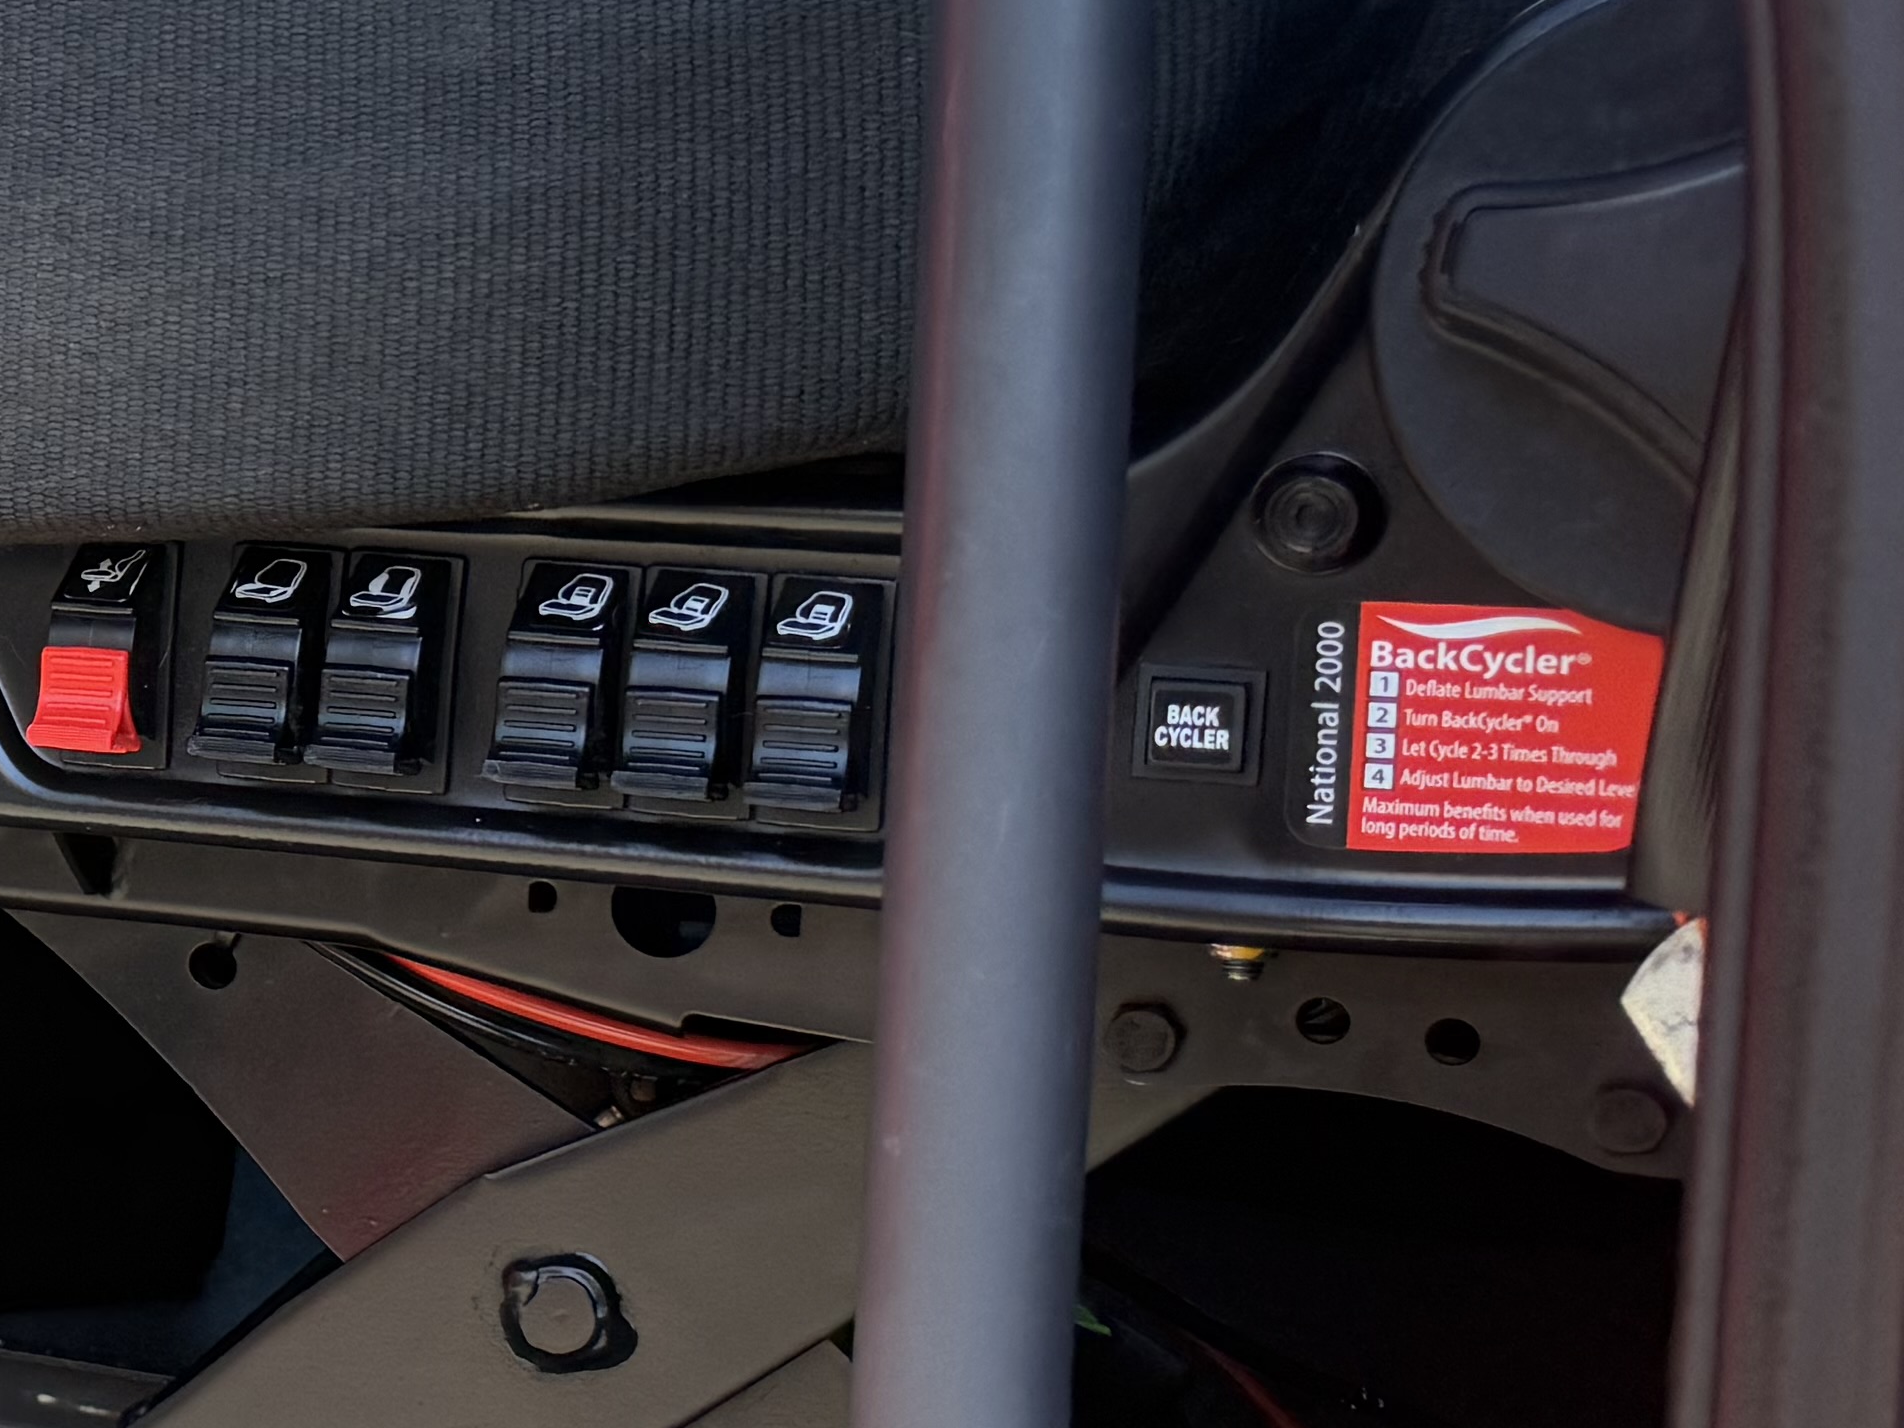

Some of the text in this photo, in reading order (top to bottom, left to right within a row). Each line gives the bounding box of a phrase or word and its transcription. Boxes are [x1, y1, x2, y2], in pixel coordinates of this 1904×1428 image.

[1379, 675, 1593, 706] 1 Deflate Lumbar Support
[1167, 704, 1220, 727] BACK
[1306, 621, 1346, 826] National 2000
[1376, 707, 1389, 723] 2
[1404, 709, 1438, 727] Turn
[1536, 716, 1560, 733] On
[1154, 725, 1230, 750] CYCLER
[1374, 738, 1618, 770] 3 Let Cycle 2-3 Times Through
[1371, 768, 1384, 784] 4
[1400, 768, 1449, 790] Adjust
[1452, 771, 1513, 791] Lumbar
[1516, 776, 1533, 792] to
[1536, 777, 1594, 796] Desired
[1362, 797, 1623, 829] Maximum benefits when used for
[1361, 817, 1519, 844] long periods of time.
